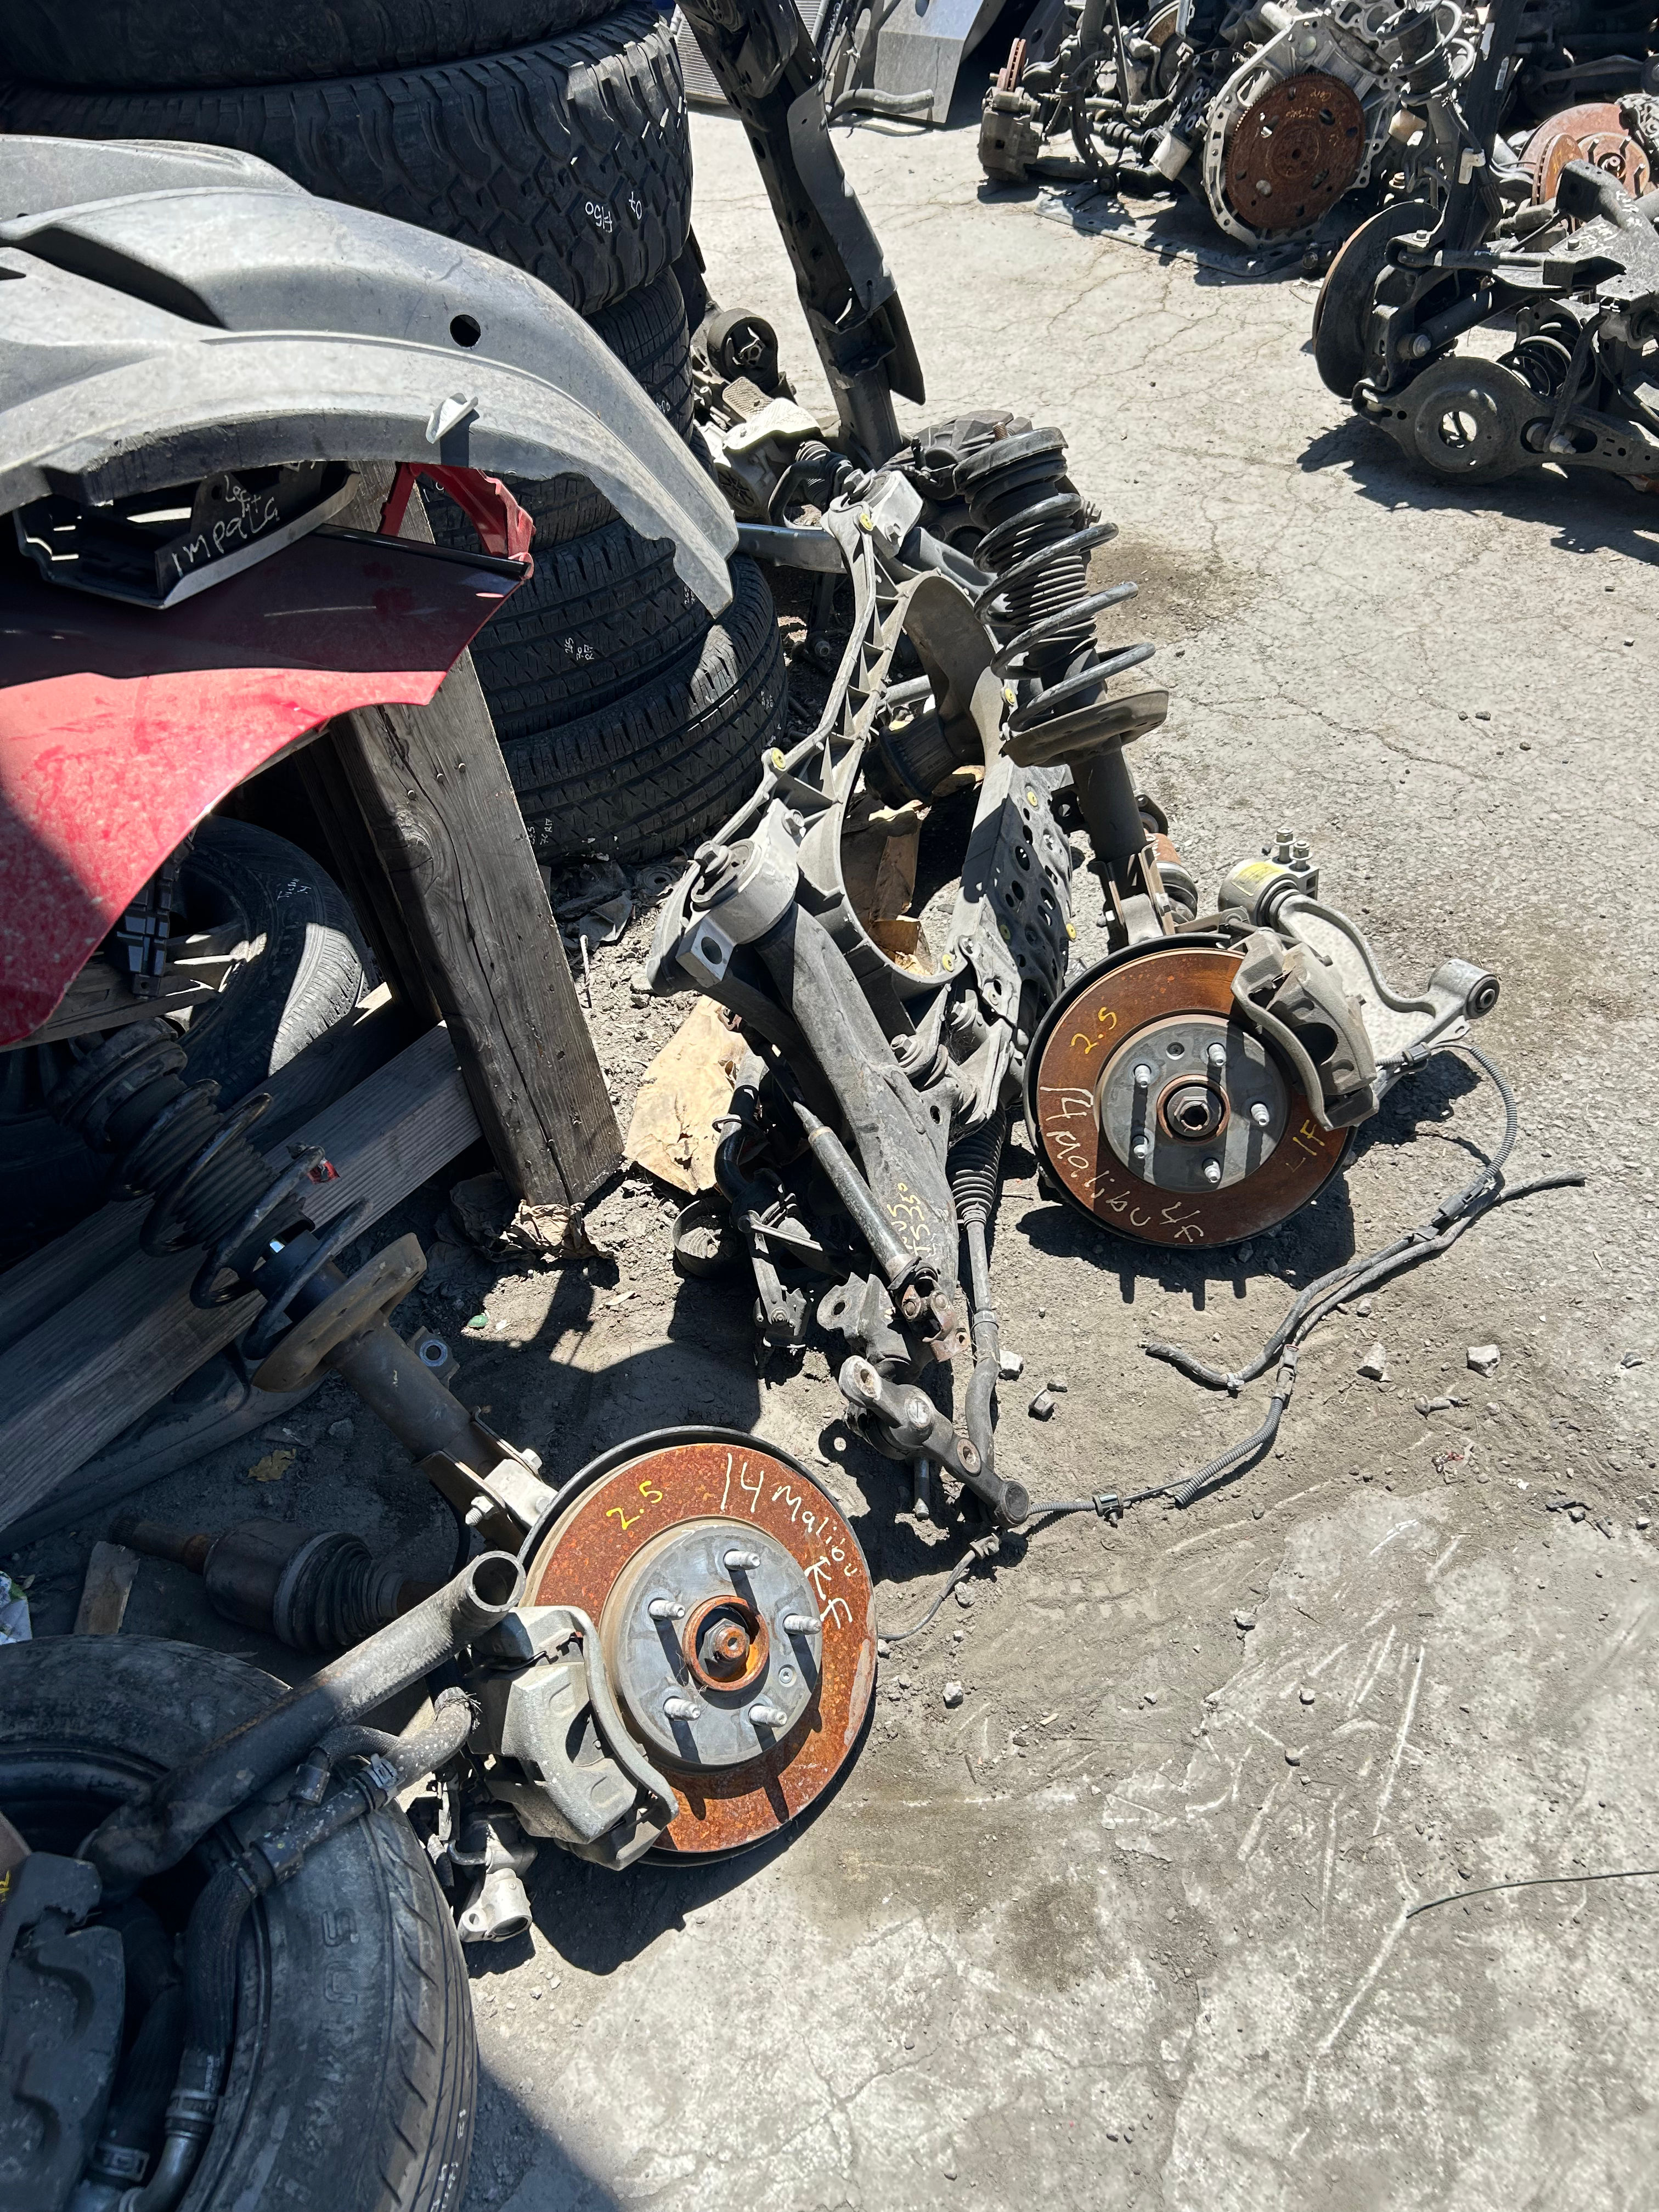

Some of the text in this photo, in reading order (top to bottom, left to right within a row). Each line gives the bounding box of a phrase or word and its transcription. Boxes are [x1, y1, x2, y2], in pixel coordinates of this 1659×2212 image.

[224, 475, 262, 518] Left
[544, 817, 553, 833] R17
[1070, 1007, 1118, 1054] 2.5
[1040, 1086, 1094, 1121] 14
[720, 1452, 765, 1513] 14
[606, 1480, 663, 1531] 2.5
